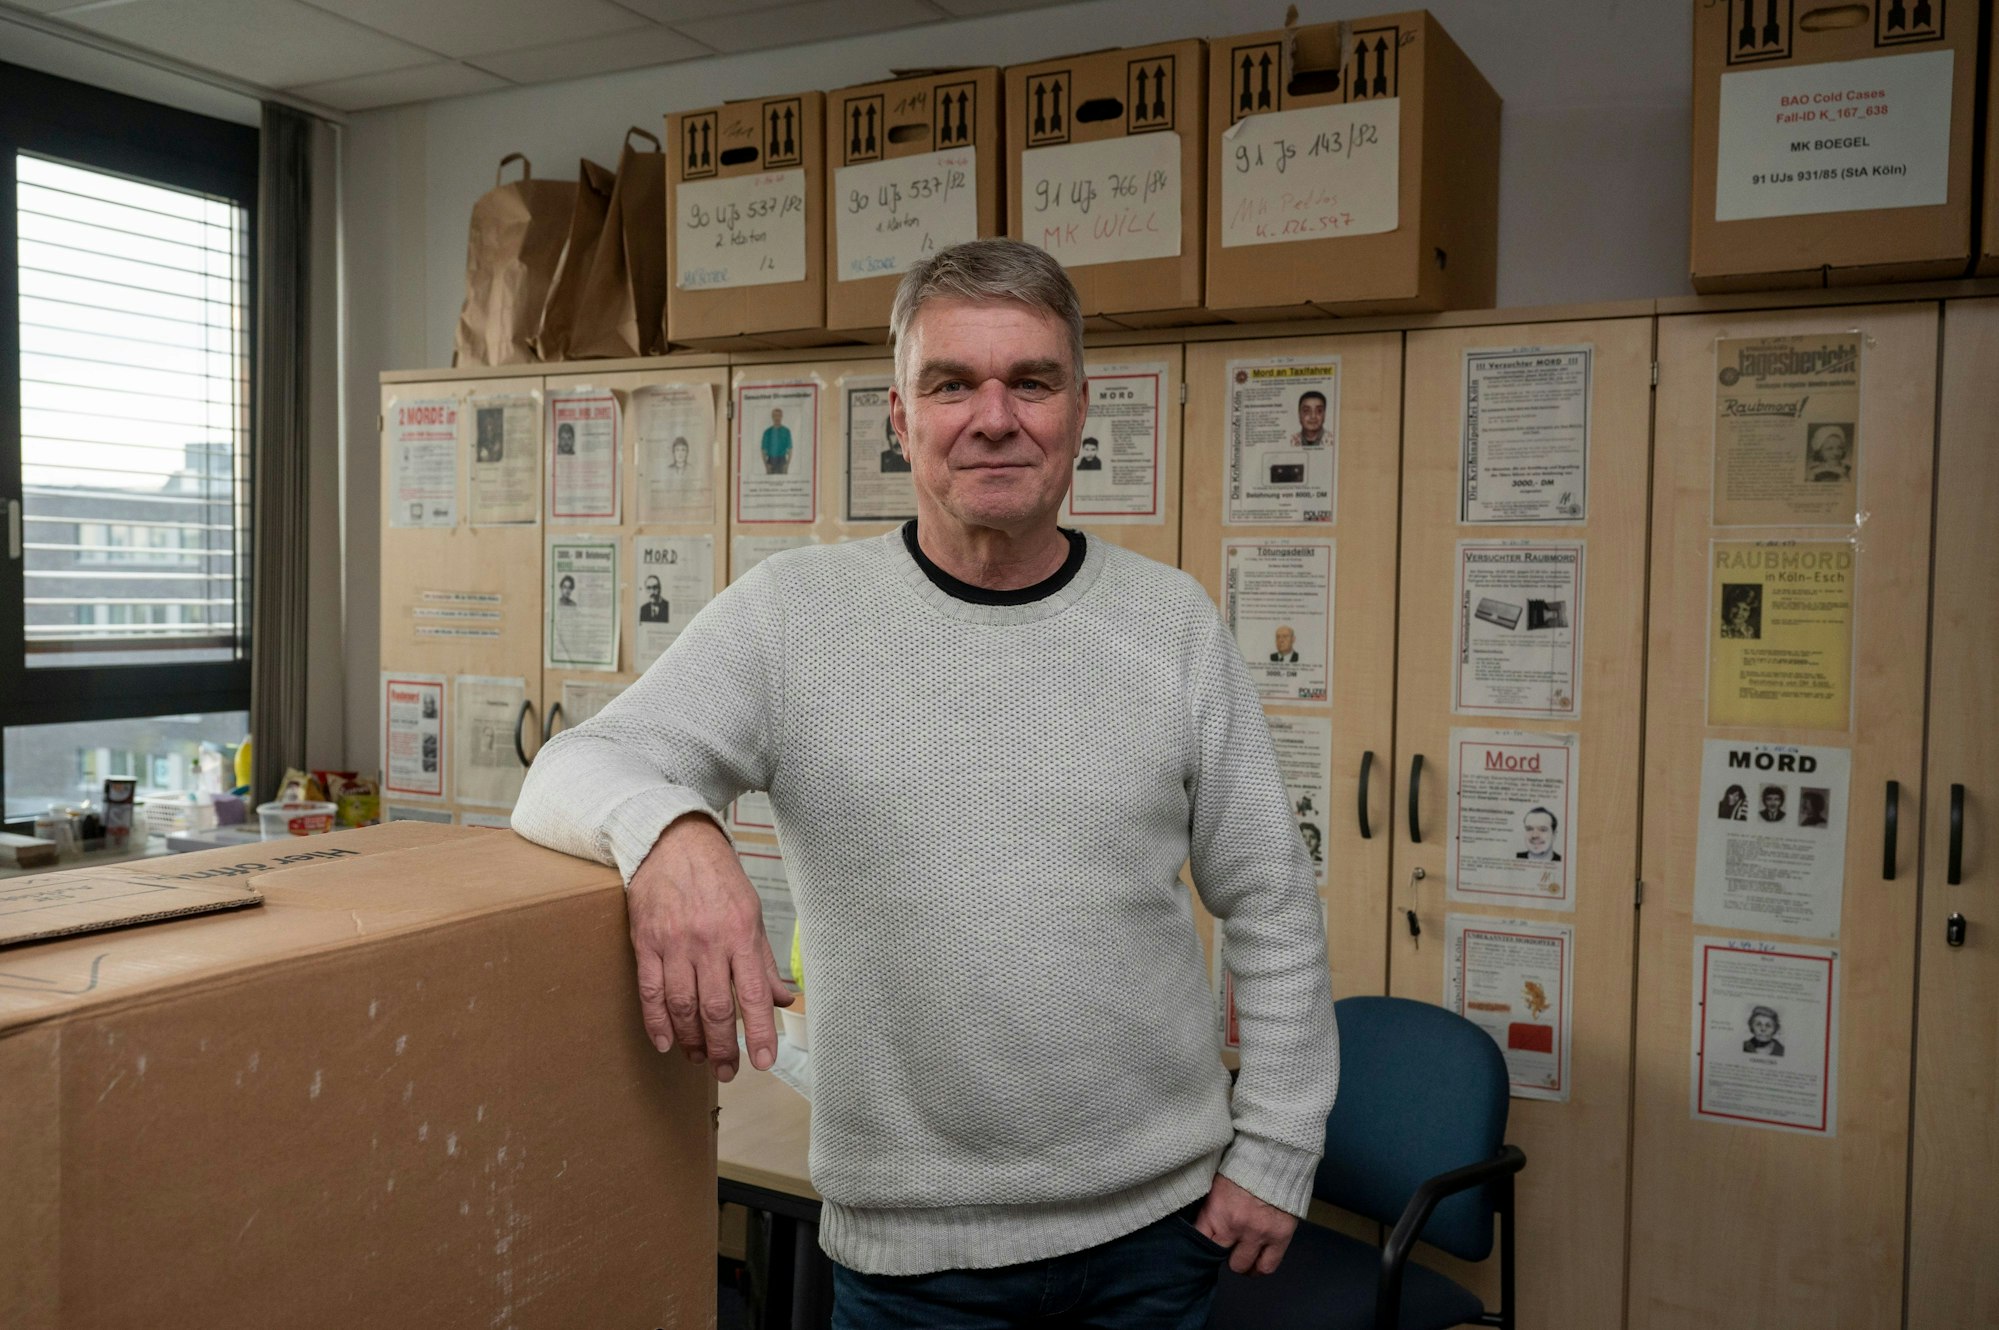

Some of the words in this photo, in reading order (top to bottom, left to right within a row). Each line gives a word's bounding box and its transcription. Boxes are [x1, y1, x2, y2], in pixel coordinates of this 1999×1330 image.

[1781, 94, 1809, 107] BAO
[1813, 91, 1843, 105] Cold
[1846, 88, 1886, 102] Cases
[1776, 111, 1816, 124] Fall-ID
[1819, 104, 1889, 122] K_167_638
[1790, 141, 1811, 153] MK
[1814, 136, 1871, 151] BOEGEL
[1752, 173, 1767, 185] 91
[1770, 171, 1794, 184] UJs
[1797, 167, 1838, 182] 931/85
[1841, 165, 1868, 181] (StA
[1872, 163, 1908, 178] Köln)
[1043, 223, 1080, 252] MK
[1253, 368, 1275, 378] Mord
[1276, 368, 1288, 377] an
[1290, 366, 1333, 378] Taxifahrer
[1099, 391, 1135, 400] MORD
[407, 406, 445, 426] MORDE
[643, 548, 678, 564] MORD
[1715, 550, 1851, 570] RAUBMORD
[1765, 571, 1776, 582] in
[1485, 749, 1541, 771] Mord
[1728, 750, 1818, 775] MORD
[271, 847, 362, 866] Hier
